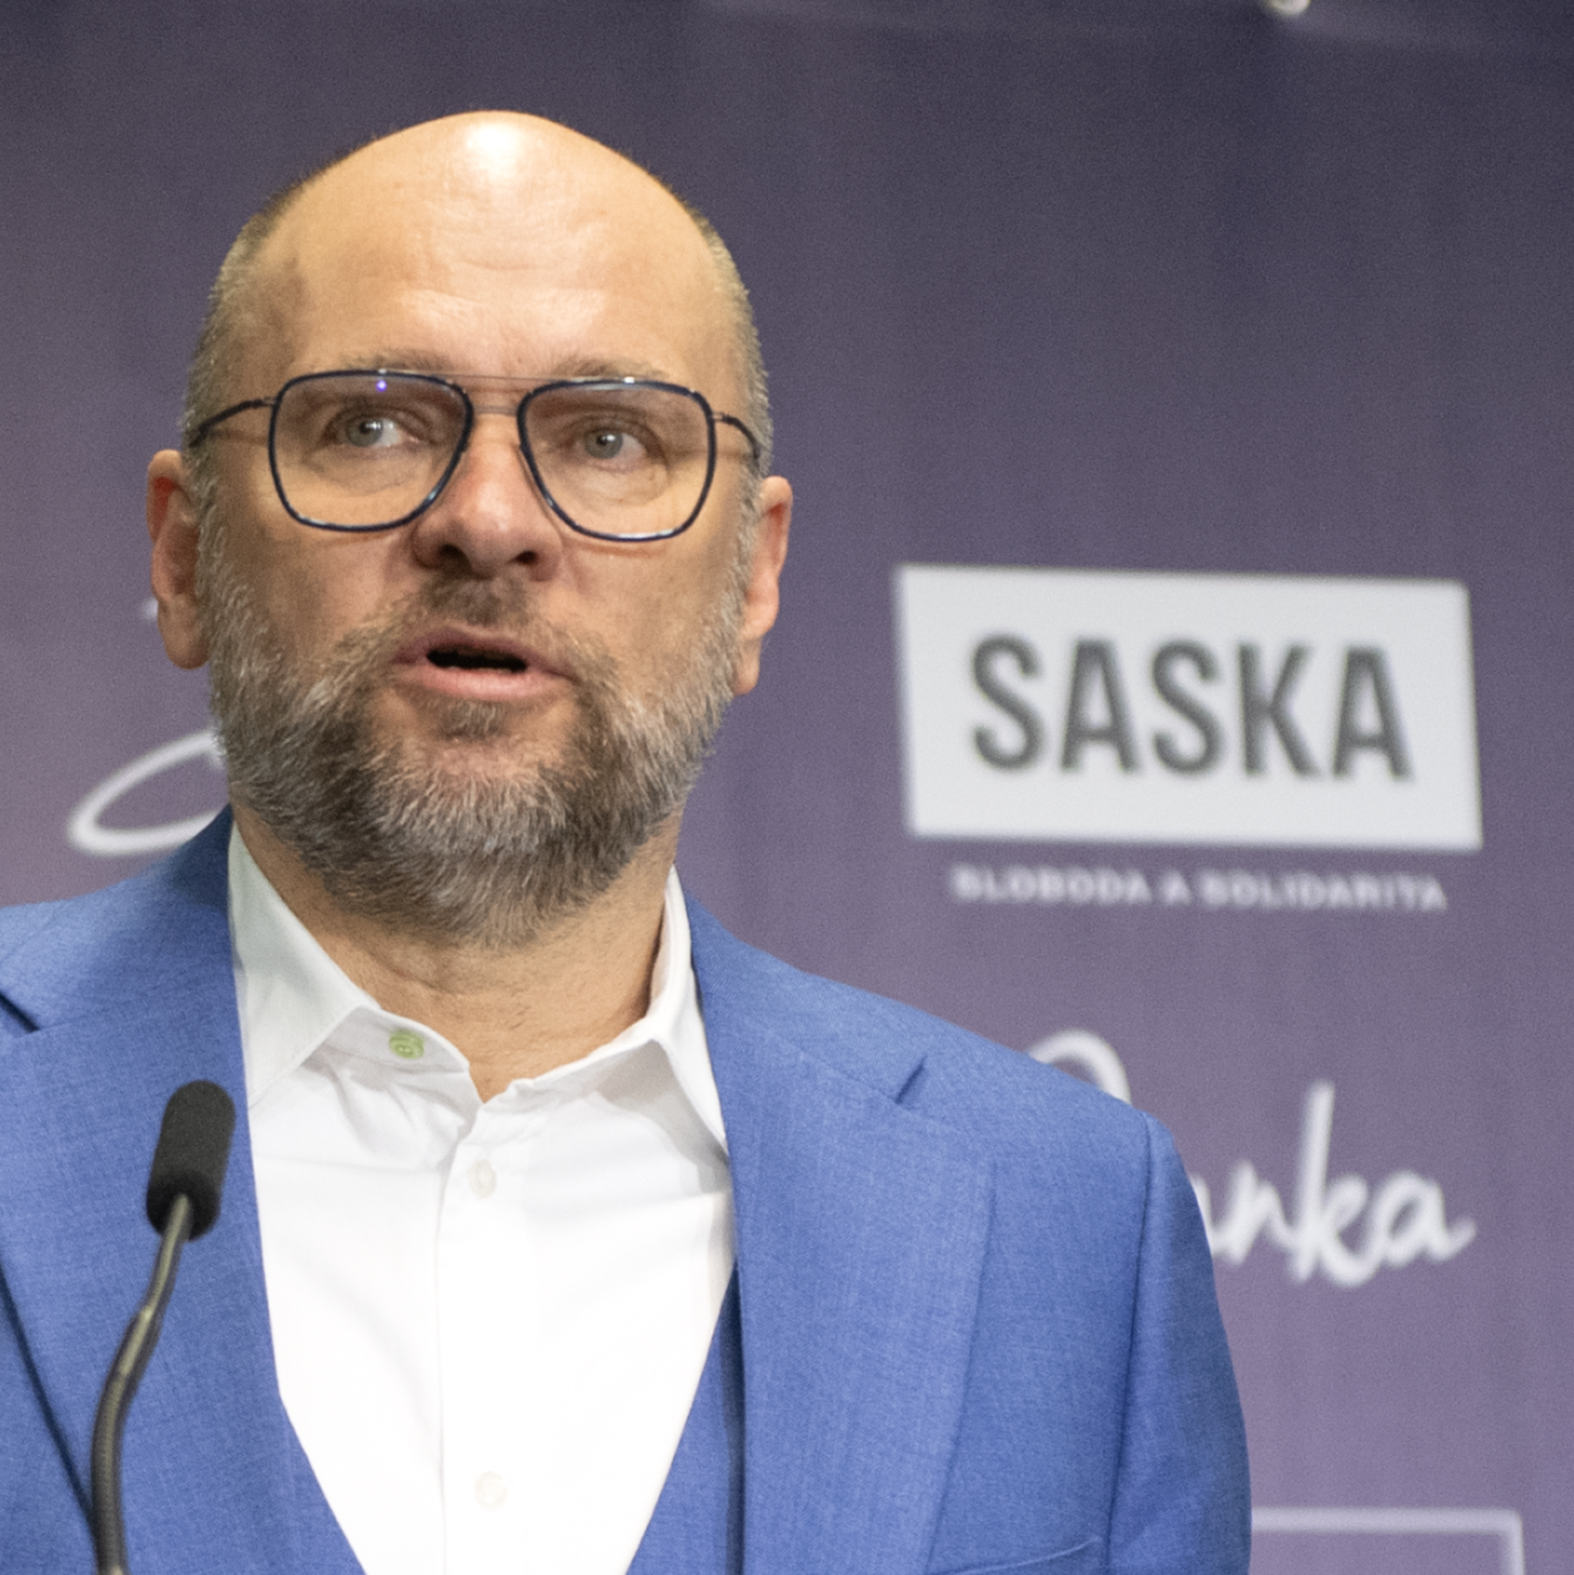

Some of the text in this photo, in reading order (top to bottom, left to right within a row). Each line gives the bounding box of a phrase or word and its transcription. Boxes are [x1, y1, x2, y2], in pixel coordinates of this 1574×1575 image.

[970, 632, 1415, 782] SASKA
[949, 864, 1449, 914] SLOBODA A SOLIDARITA
